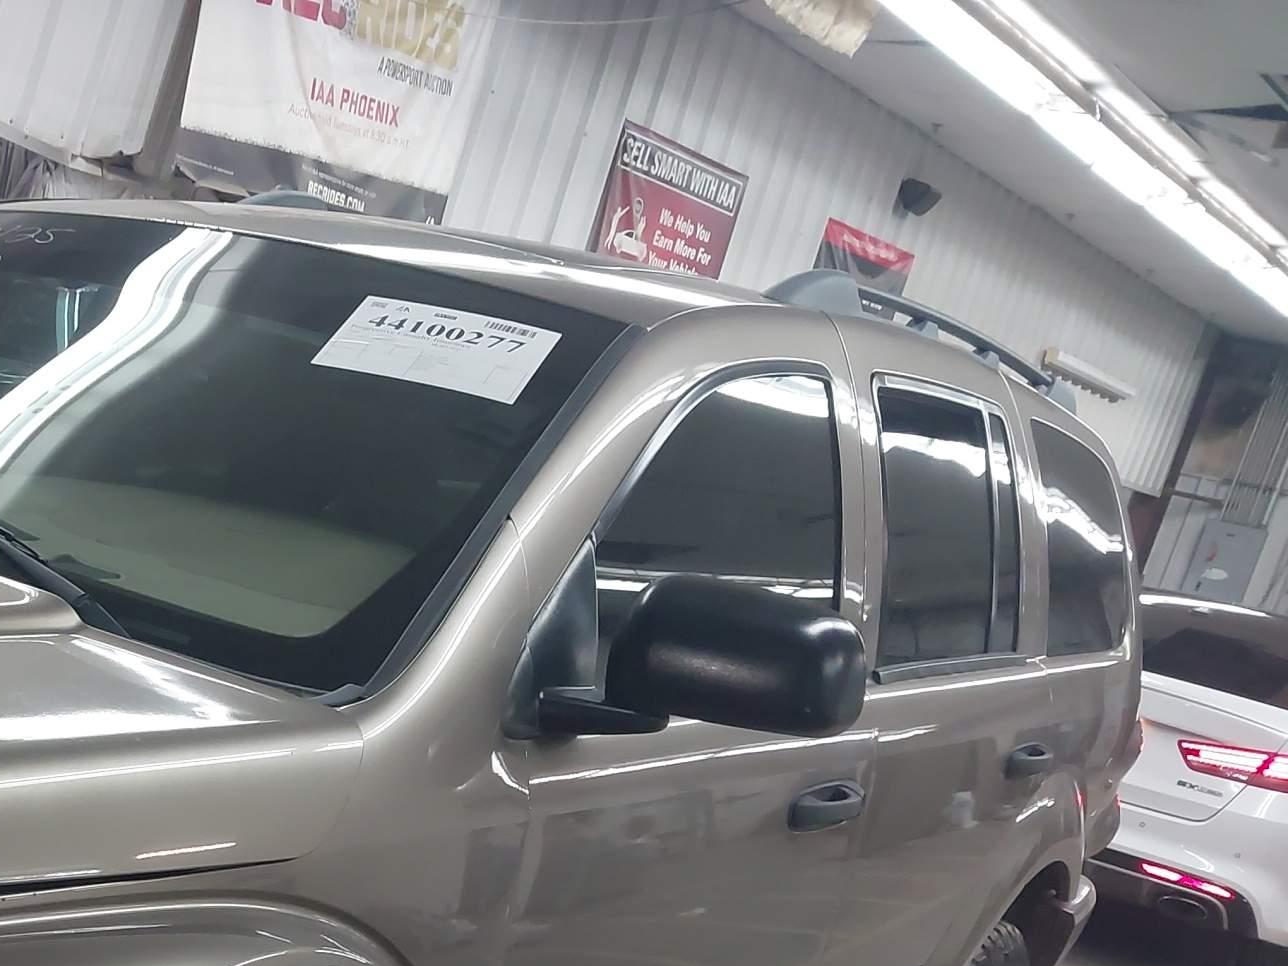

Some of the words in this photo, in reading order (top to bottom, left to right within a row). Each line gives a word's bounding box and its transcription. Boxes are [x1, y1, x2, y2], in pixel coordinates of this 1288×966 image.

[424, 71, 453, 96] AUCTION
[310, 77, 335, 108] IAA
[339, 87, 401, 128] PHOENIX
[623, 137, 651, 171] SELL
[651, 151, 692, 187] SMART
[690, 168, 718, 200] WITH
[717, 181, 736, 209] IAA
[308, 180, 365, 212] RECRIDES.COM
[660, 208, 673, 227] We
[674, 214, 694, 239] Help
[696, 222, 711, 243] You
[649, 250, 667, 269] Your
[653, 230, 673, 252] Earn
[674, 238, 696, 260] More
[697, 247, 711, 266] For
[368, 314, 527, 353] 44100277
